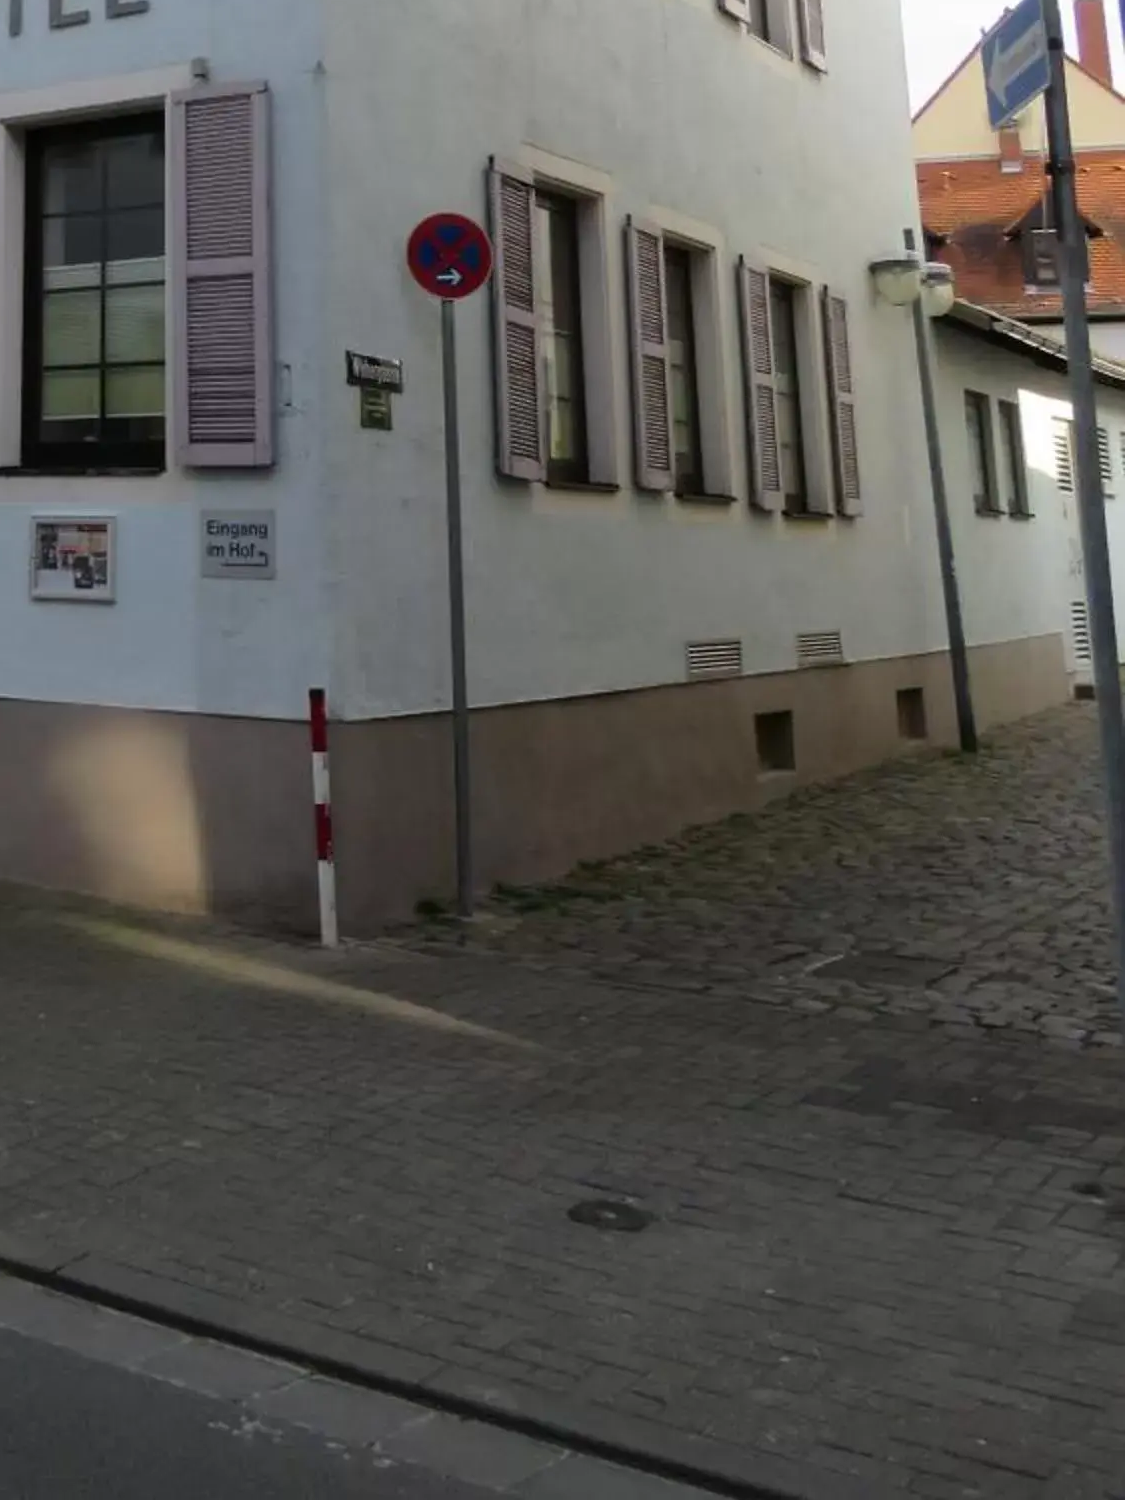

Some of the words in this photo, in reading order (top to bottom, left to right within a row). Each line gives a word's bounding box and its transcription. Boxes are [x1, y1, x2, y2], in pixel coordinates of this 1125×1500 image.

[206, 519, 269, 540] Eingang
[206, 541, 225, 557] im
[229, 541, 256, 558] Hof
